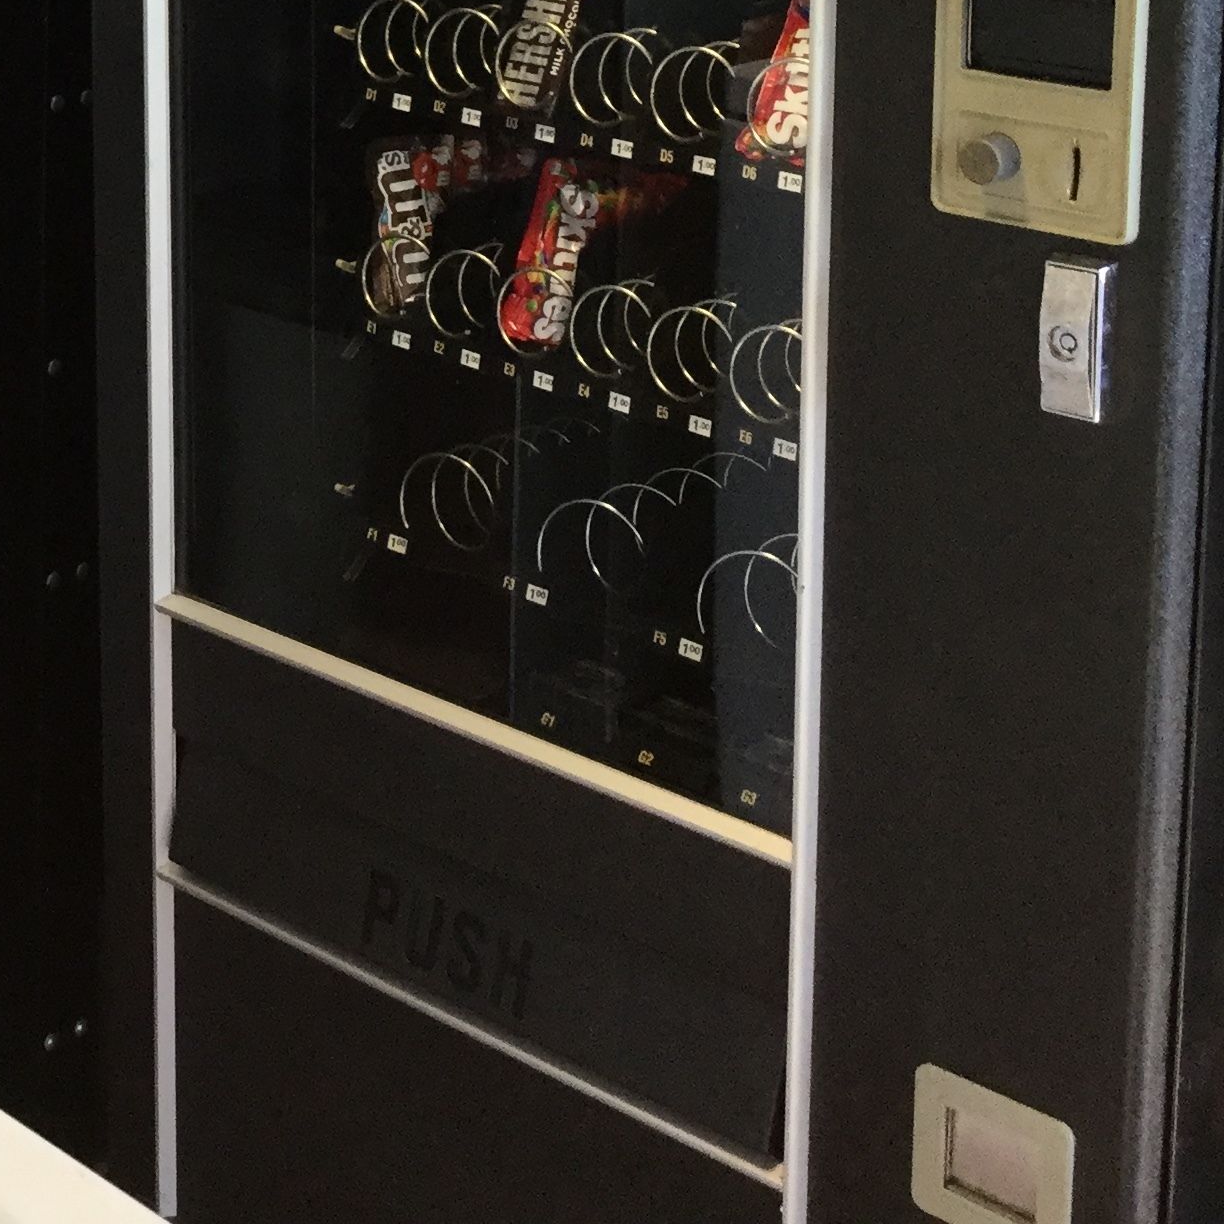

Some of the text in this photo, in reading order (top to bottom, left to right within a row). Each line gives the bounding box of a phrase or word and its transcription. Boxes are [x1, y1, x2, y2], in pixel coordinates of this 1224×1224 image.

[550, 47, 565, 76] MILK
[580, 133, 594, 148] D4
[659, 148, 674, 164] D5
[742, 165, 757, 181] D6
[578, 383, 590, 398] E4
[656, 405, 669, 419] E5
[739, 429, 753, 444] E6
[367, 528, 378, 541] F1
[502, 576, 516, 591] F3
[653, 630, 667, 646] F5
[362, 871, 534, 1020] PUSH
